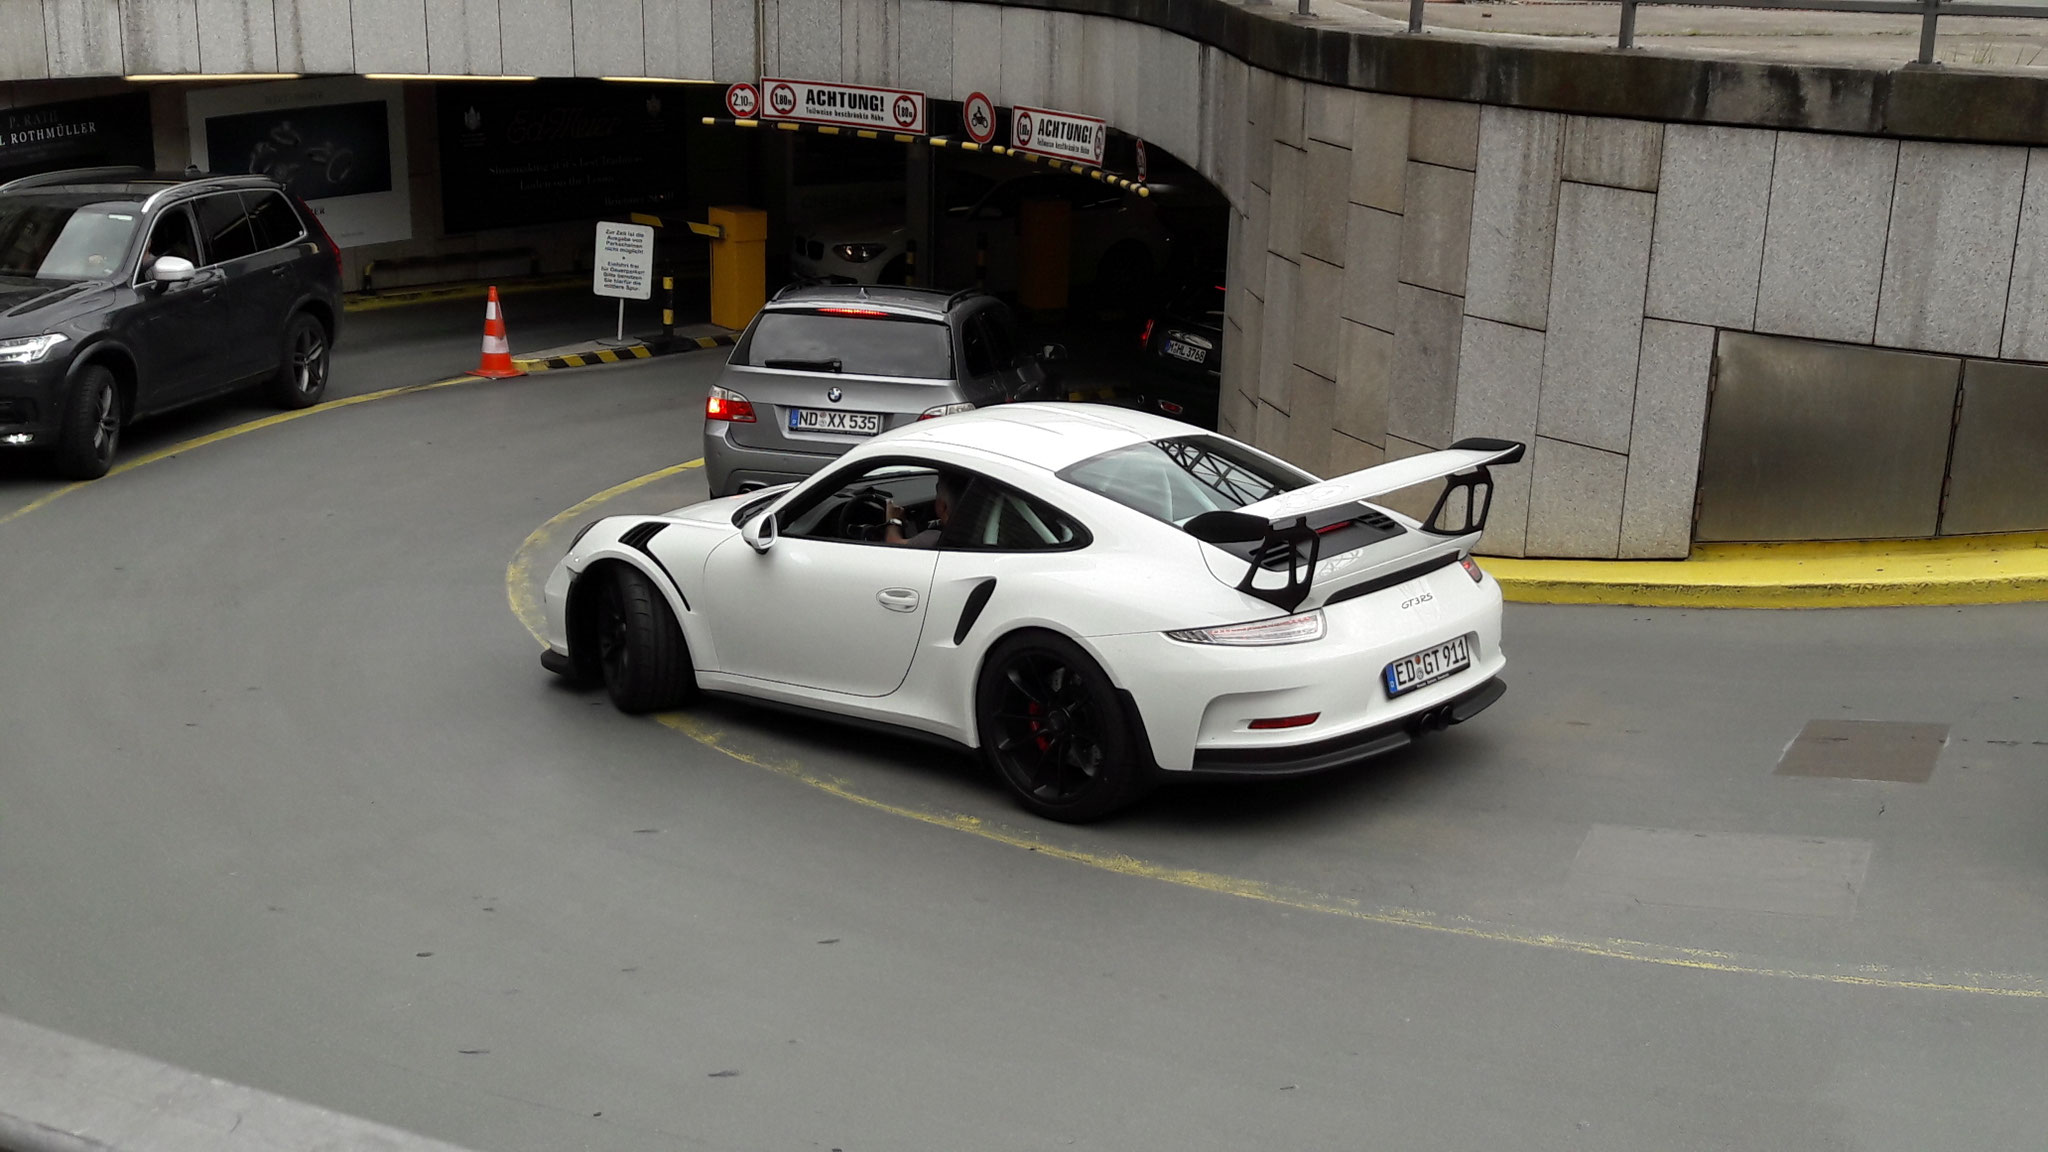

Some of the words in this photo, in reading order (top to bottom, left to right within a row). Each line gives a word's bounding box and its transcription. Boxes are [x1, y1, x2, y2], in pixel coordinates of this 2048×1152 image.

[805, 88, 884, 112] ACHTUNG!
[10, 121, 96, 145] ROTHMÜLLER
[1037, 118, 1093, 144] ACHTUNG!
[799, 411, 818, 426] ND
[827, 412, 846, 429] XX
[849, 414, 876, 431] 535
[1395, 659, 1416, 686] ED
[1423, 649, 1440, 675] GT
[1442, 639, 1467, 668] 911
